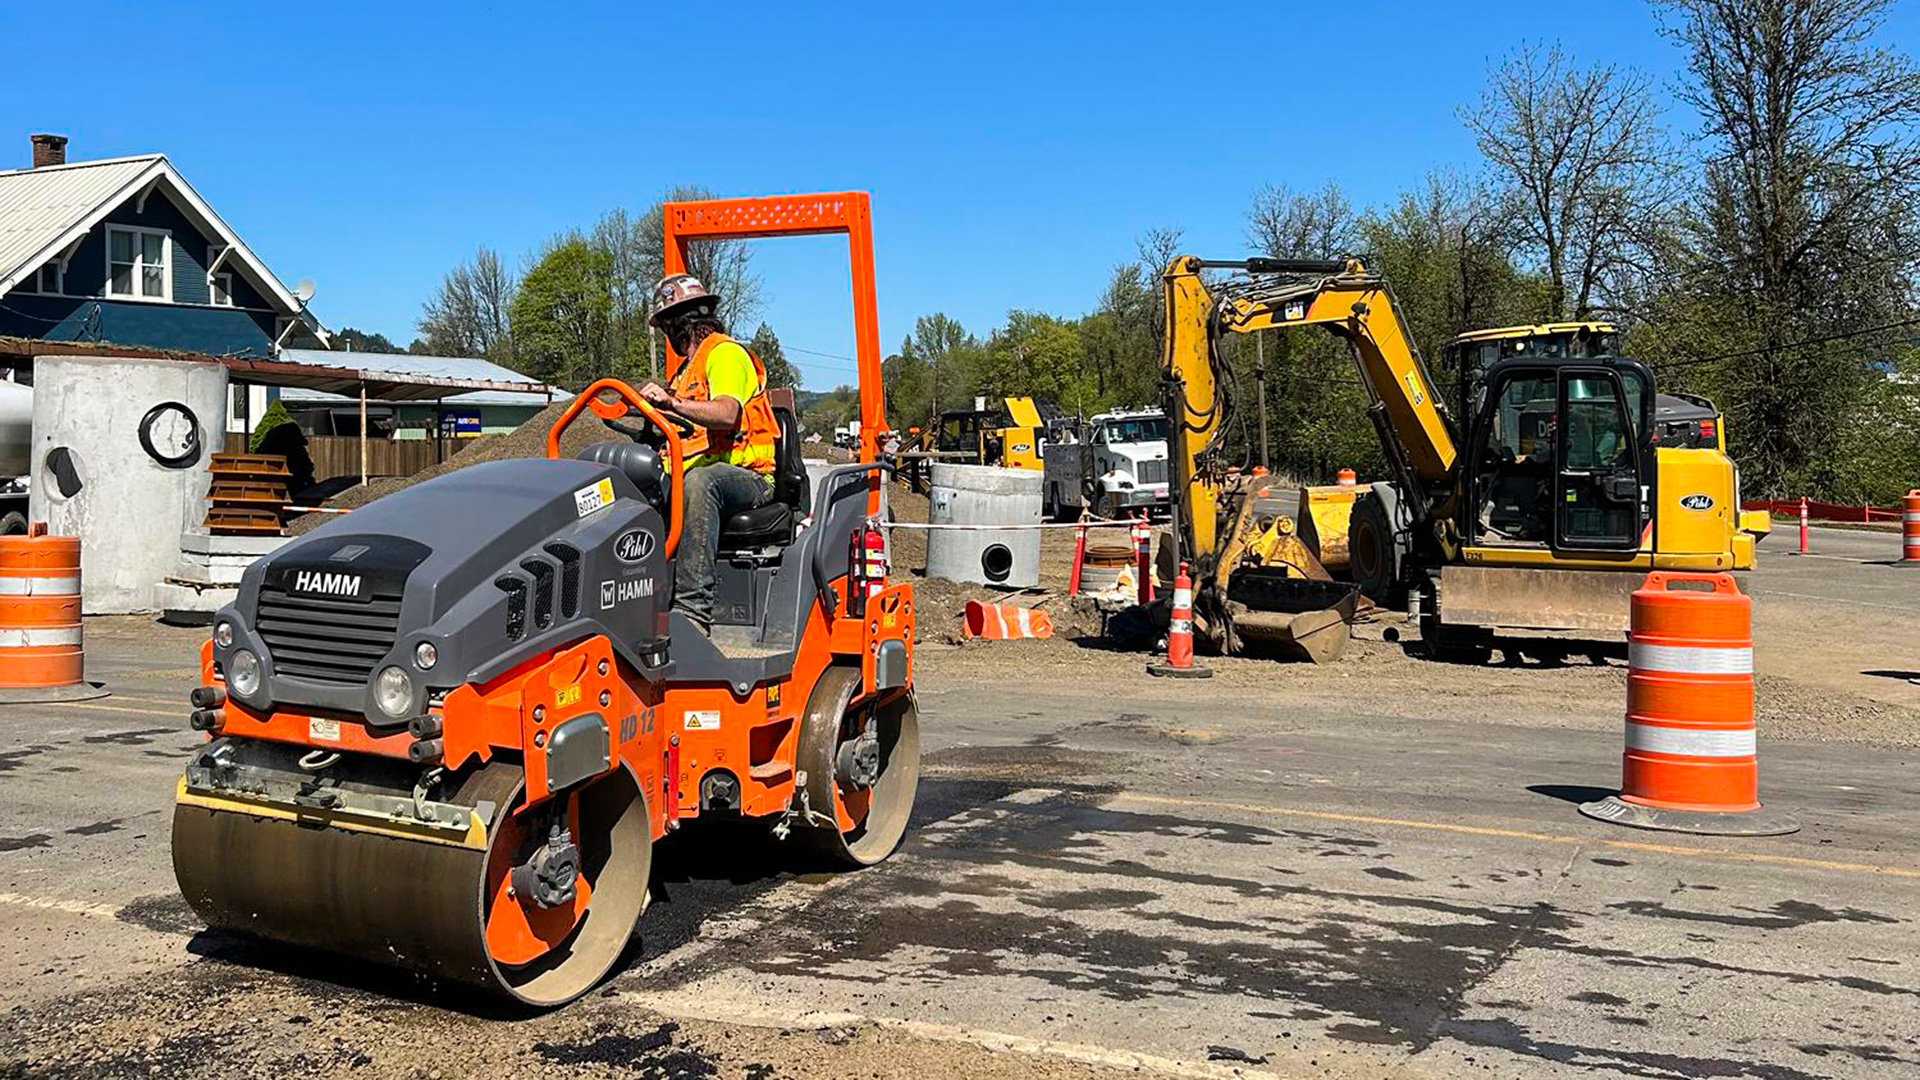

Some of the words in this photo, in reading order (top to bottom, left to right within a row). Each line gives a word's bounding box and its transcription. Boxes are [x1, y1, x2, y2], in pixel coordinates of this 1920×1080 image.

[1285, 302, 1304, 320] CAT
[579, 494, 601, 514] 80127
[620, 533, 649, 559] Pihl
[295, 570, 361, 596] HAMM
[617, 577, 654, 602] HAMM
[620, 714, 638, 743] HD
[641, 705, 656, 735] 12
